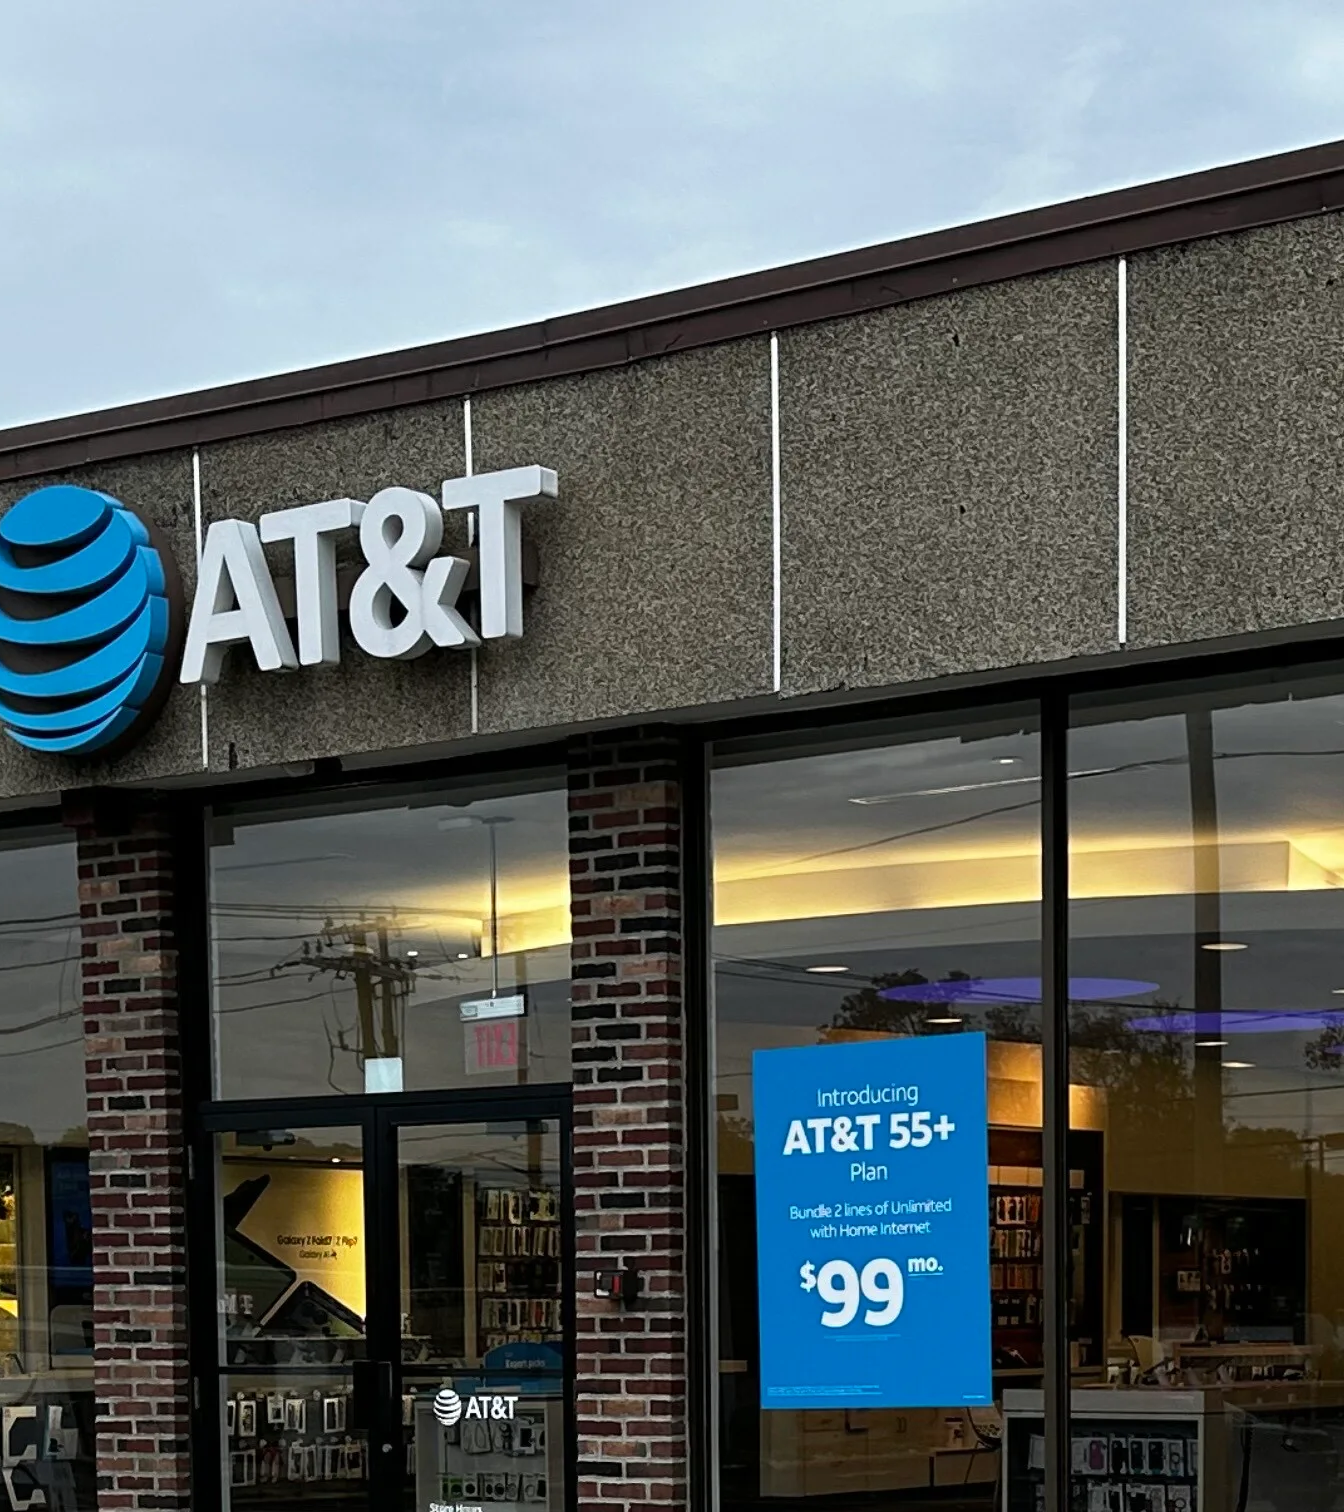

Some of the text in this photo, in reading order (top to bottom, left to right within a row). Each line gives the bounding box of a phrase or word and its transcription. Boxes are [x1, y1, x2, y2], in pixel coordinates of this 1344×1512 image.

[179, 464, 558, 685] AT&T
[817, 1083, 919, 1107] Introducing
[783, 1111, 956, 1156] AT&T 55+
[850, 1161, 888, 1182] Plan
[790, 1198, 952, 1220] Bundle 2 lines of Unlimited
[277, 1235, 305, 1247] Galaxy
[810, 1220, 931, 1239] with Home Internet
[799, 1256, 944, 1328] $99 mo.
[465, 1396, 518, 1420] AT&T
